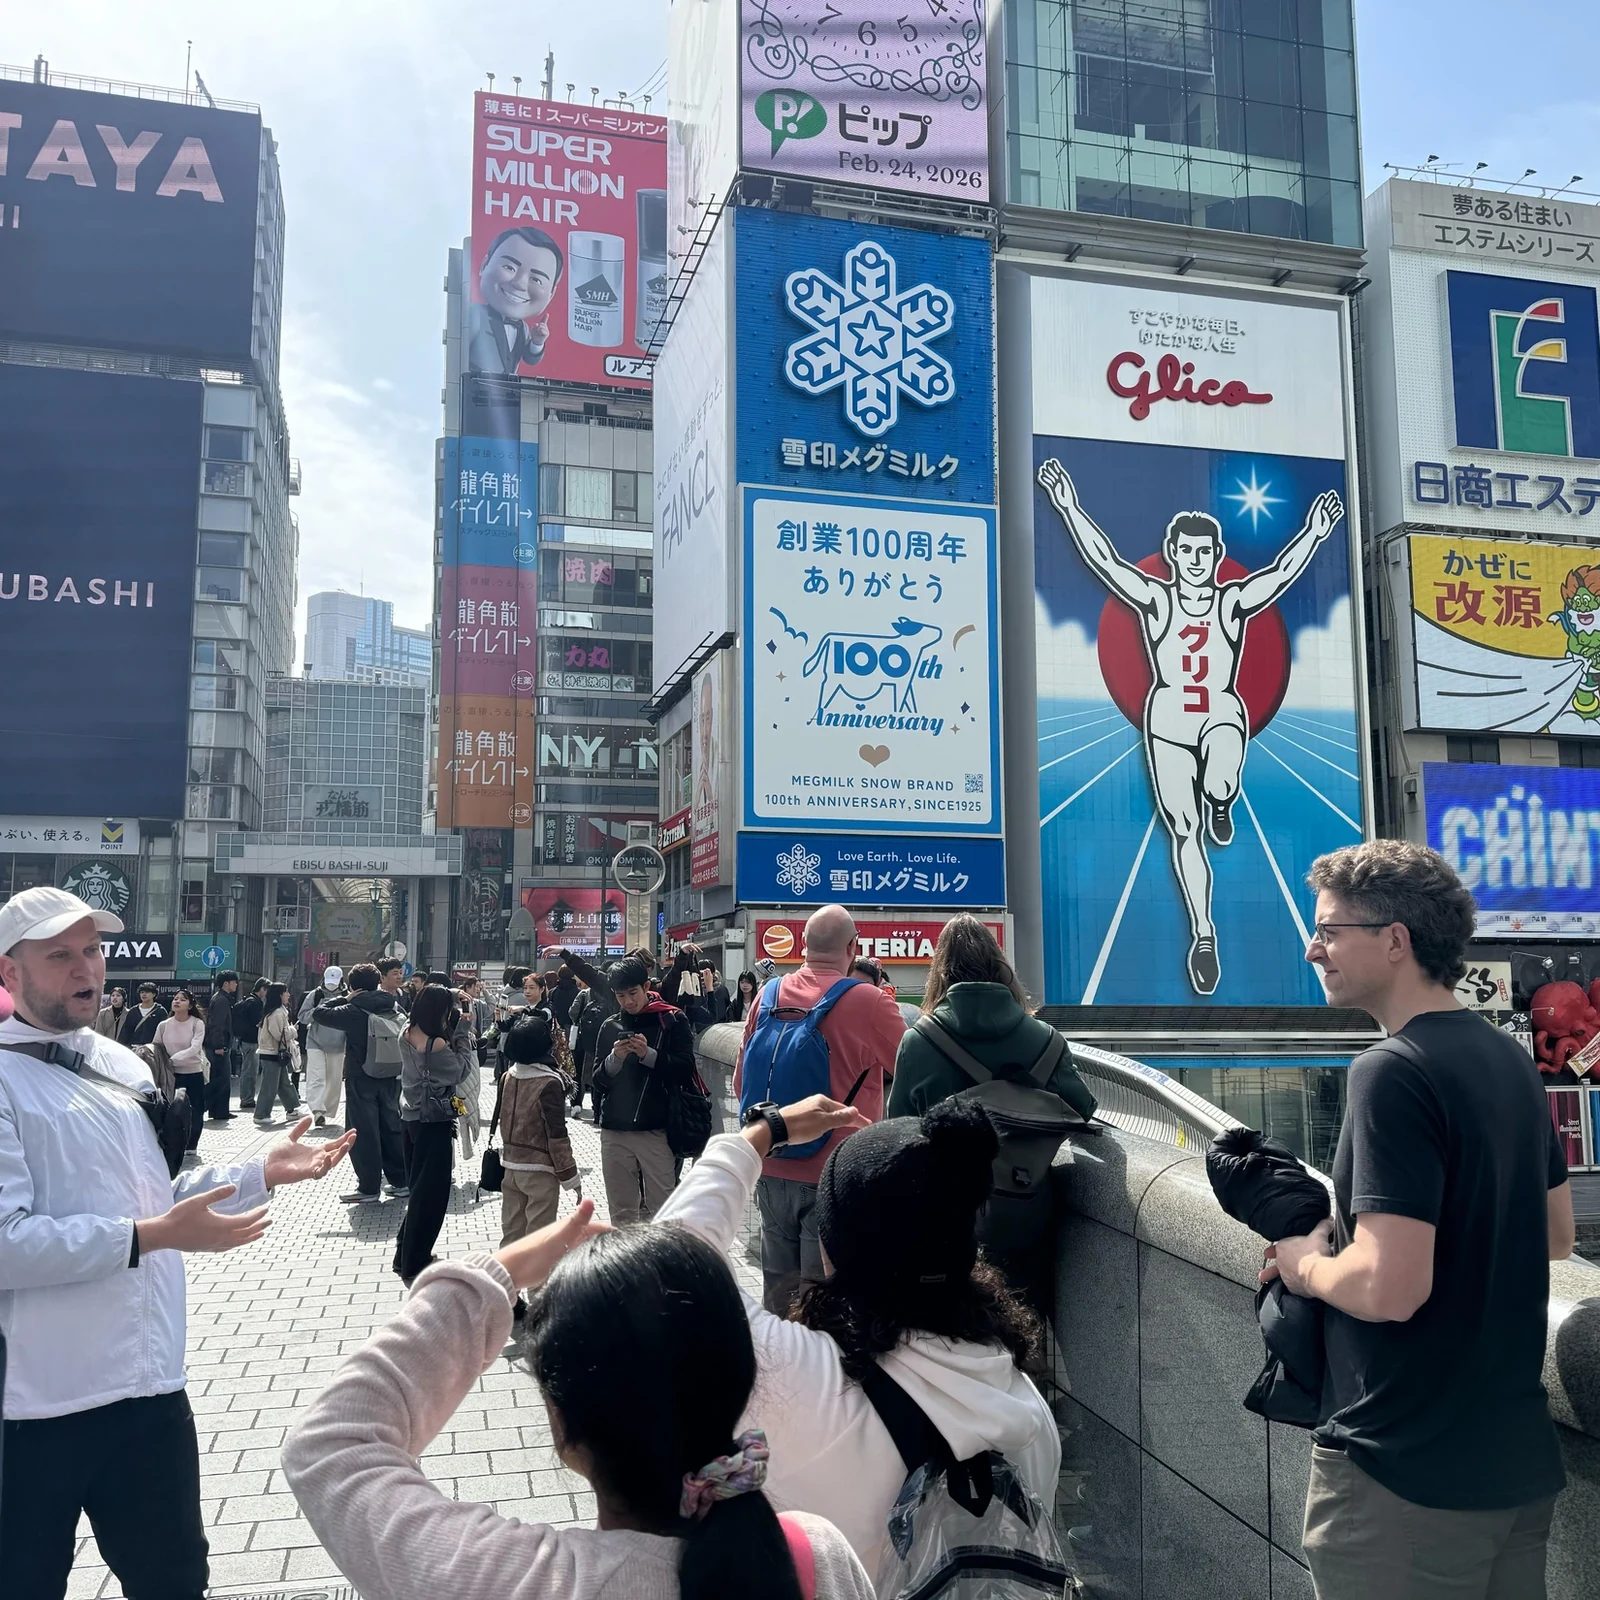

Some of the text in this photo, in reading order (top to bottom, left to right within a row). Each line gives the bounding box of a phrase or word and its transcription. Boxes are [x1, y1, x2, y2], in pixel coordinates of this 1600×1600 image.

[857, 20, 877, 46] 6
[896, 15, 918, 42] 5
[838, 102, 932, 150] ピップ
[486, 124, 612, 165] SUPER
[485, 157, 625, 200] MILLION
[838, 150, 982, 189] Feb. 24, 2026
[484, 190, 580, 226] HAIR
[1452, 193, 1572, 227] 夢ある住まい
[1434, 224, 1595, 263] エステムシリーズ
[586, 289, 610, 301] SMH
[1129, 308, 1246, 336] すこやかな毎日、
[1138, 329, 1237, 354] ゆたかな人生
[1107, 351, 1273, 421] Glico
[781, 438, 959, 479] 雪印メグミルク
[460, 470, 521, 499] 龍角散
[662, 438, 716, 569] FANCL
[776, 519, 967, 564] 創業100周年
[1443, 549, 1532, 580] かぜに
[803, 565, 943, 603] ありがとう
[458, 599, 520, 627] 龍角散
[1433, 581, 1543, 629] 改源
[564, 645, 610, 668] 力丸
[833, 641, 943, 680] 100th
[1178, 620, 1211, 713] グリコ
[807, 707, 944, 736] Anniversary
[455, 729, 518, 757] 龍角散
[541, 734, 605, 768] NY
[328, 790, 359, 801] なんば
[791, 775, 954, 791] MEGMILK SNOW BRAND
[315, 800, 370, 818] 戎橋筋
[765, 793, 801, 806] 100th
[0, 829, 91, 841] ぶい、使える。
[546, 819, 556, 859] 焼きそば
[565, 814, 575, 863] お好み焼き
[293, 860, 389, 871] EBISU BASHI-SUJI
[837, 850, 961, 864] Love Earth. Love Life.
[829, 867, 970, 893] 雪印メグミルク
[892, 930, 922, 938] ゼッテリア
[1517, 1023, 1529, 1031] 2F
